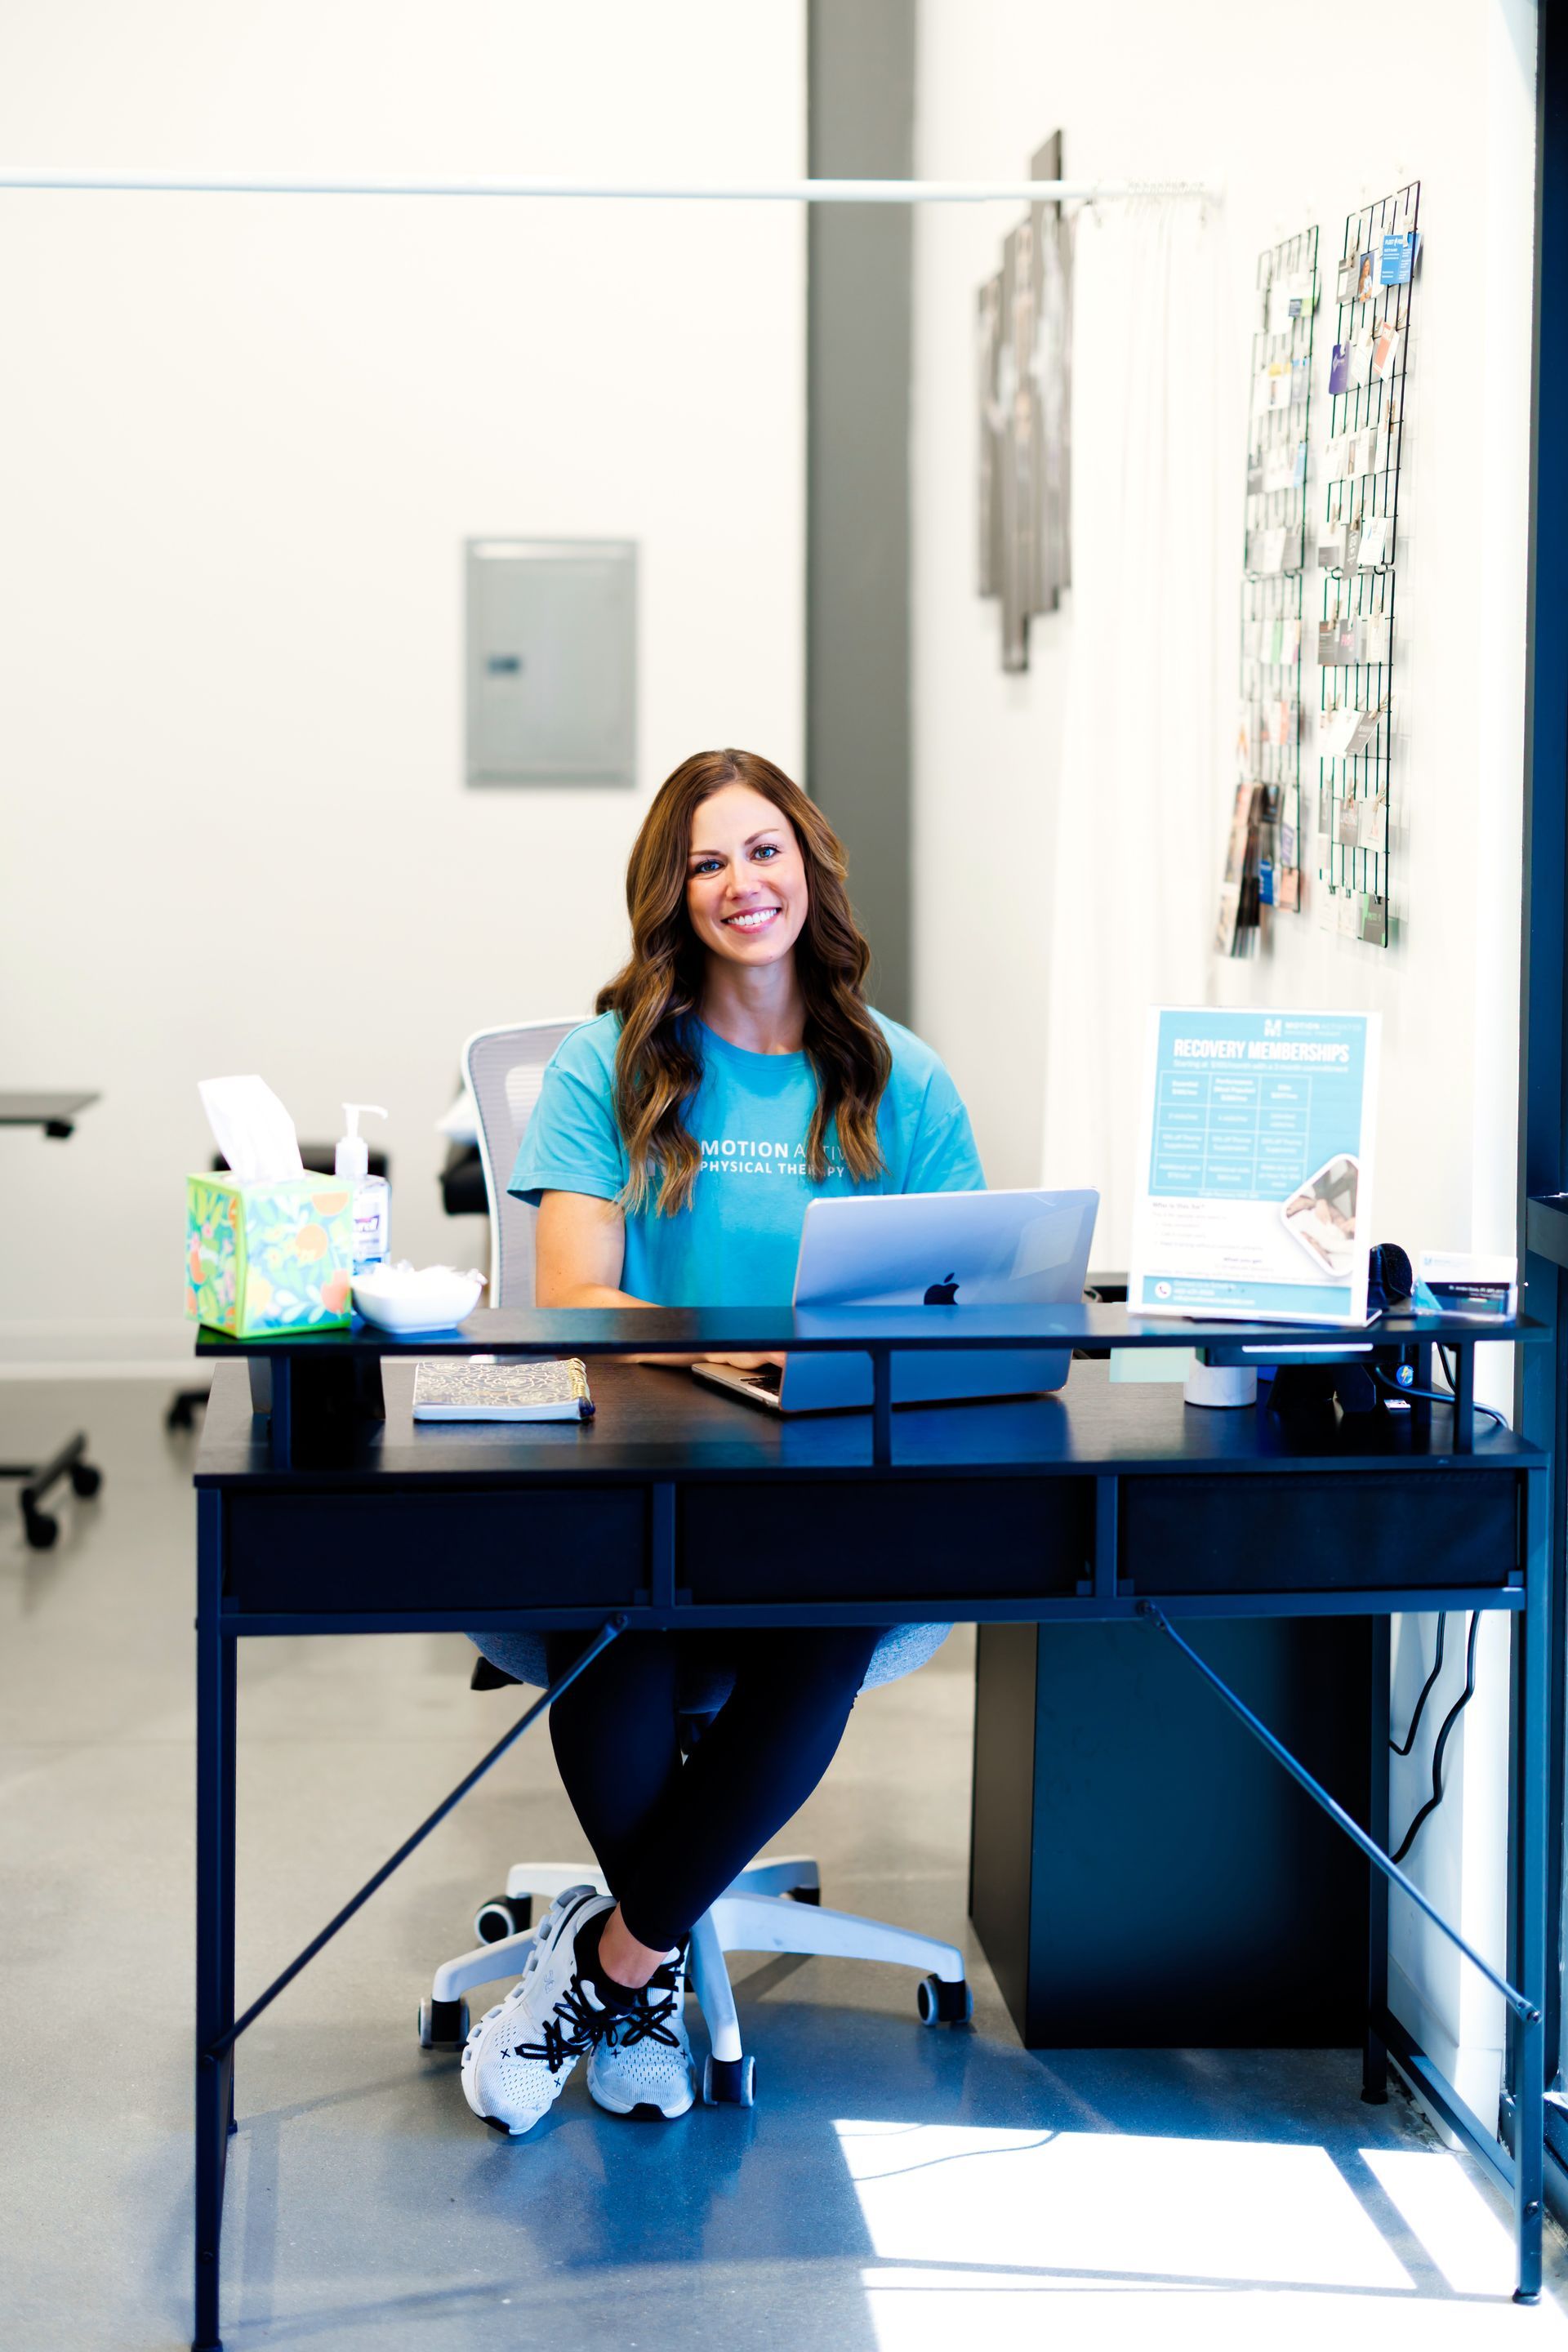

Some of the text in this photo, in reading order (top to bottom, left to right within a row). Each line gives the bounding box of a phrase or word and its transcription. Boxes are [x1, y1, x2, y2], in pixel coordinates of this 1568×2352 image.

[1174, 1039, 1350, 1063] RECOVERY MEMBERSHIPS
[701, 1139, 788, 1158] MOTION
[700, 1160, 773, 1174] PHYSICAL
